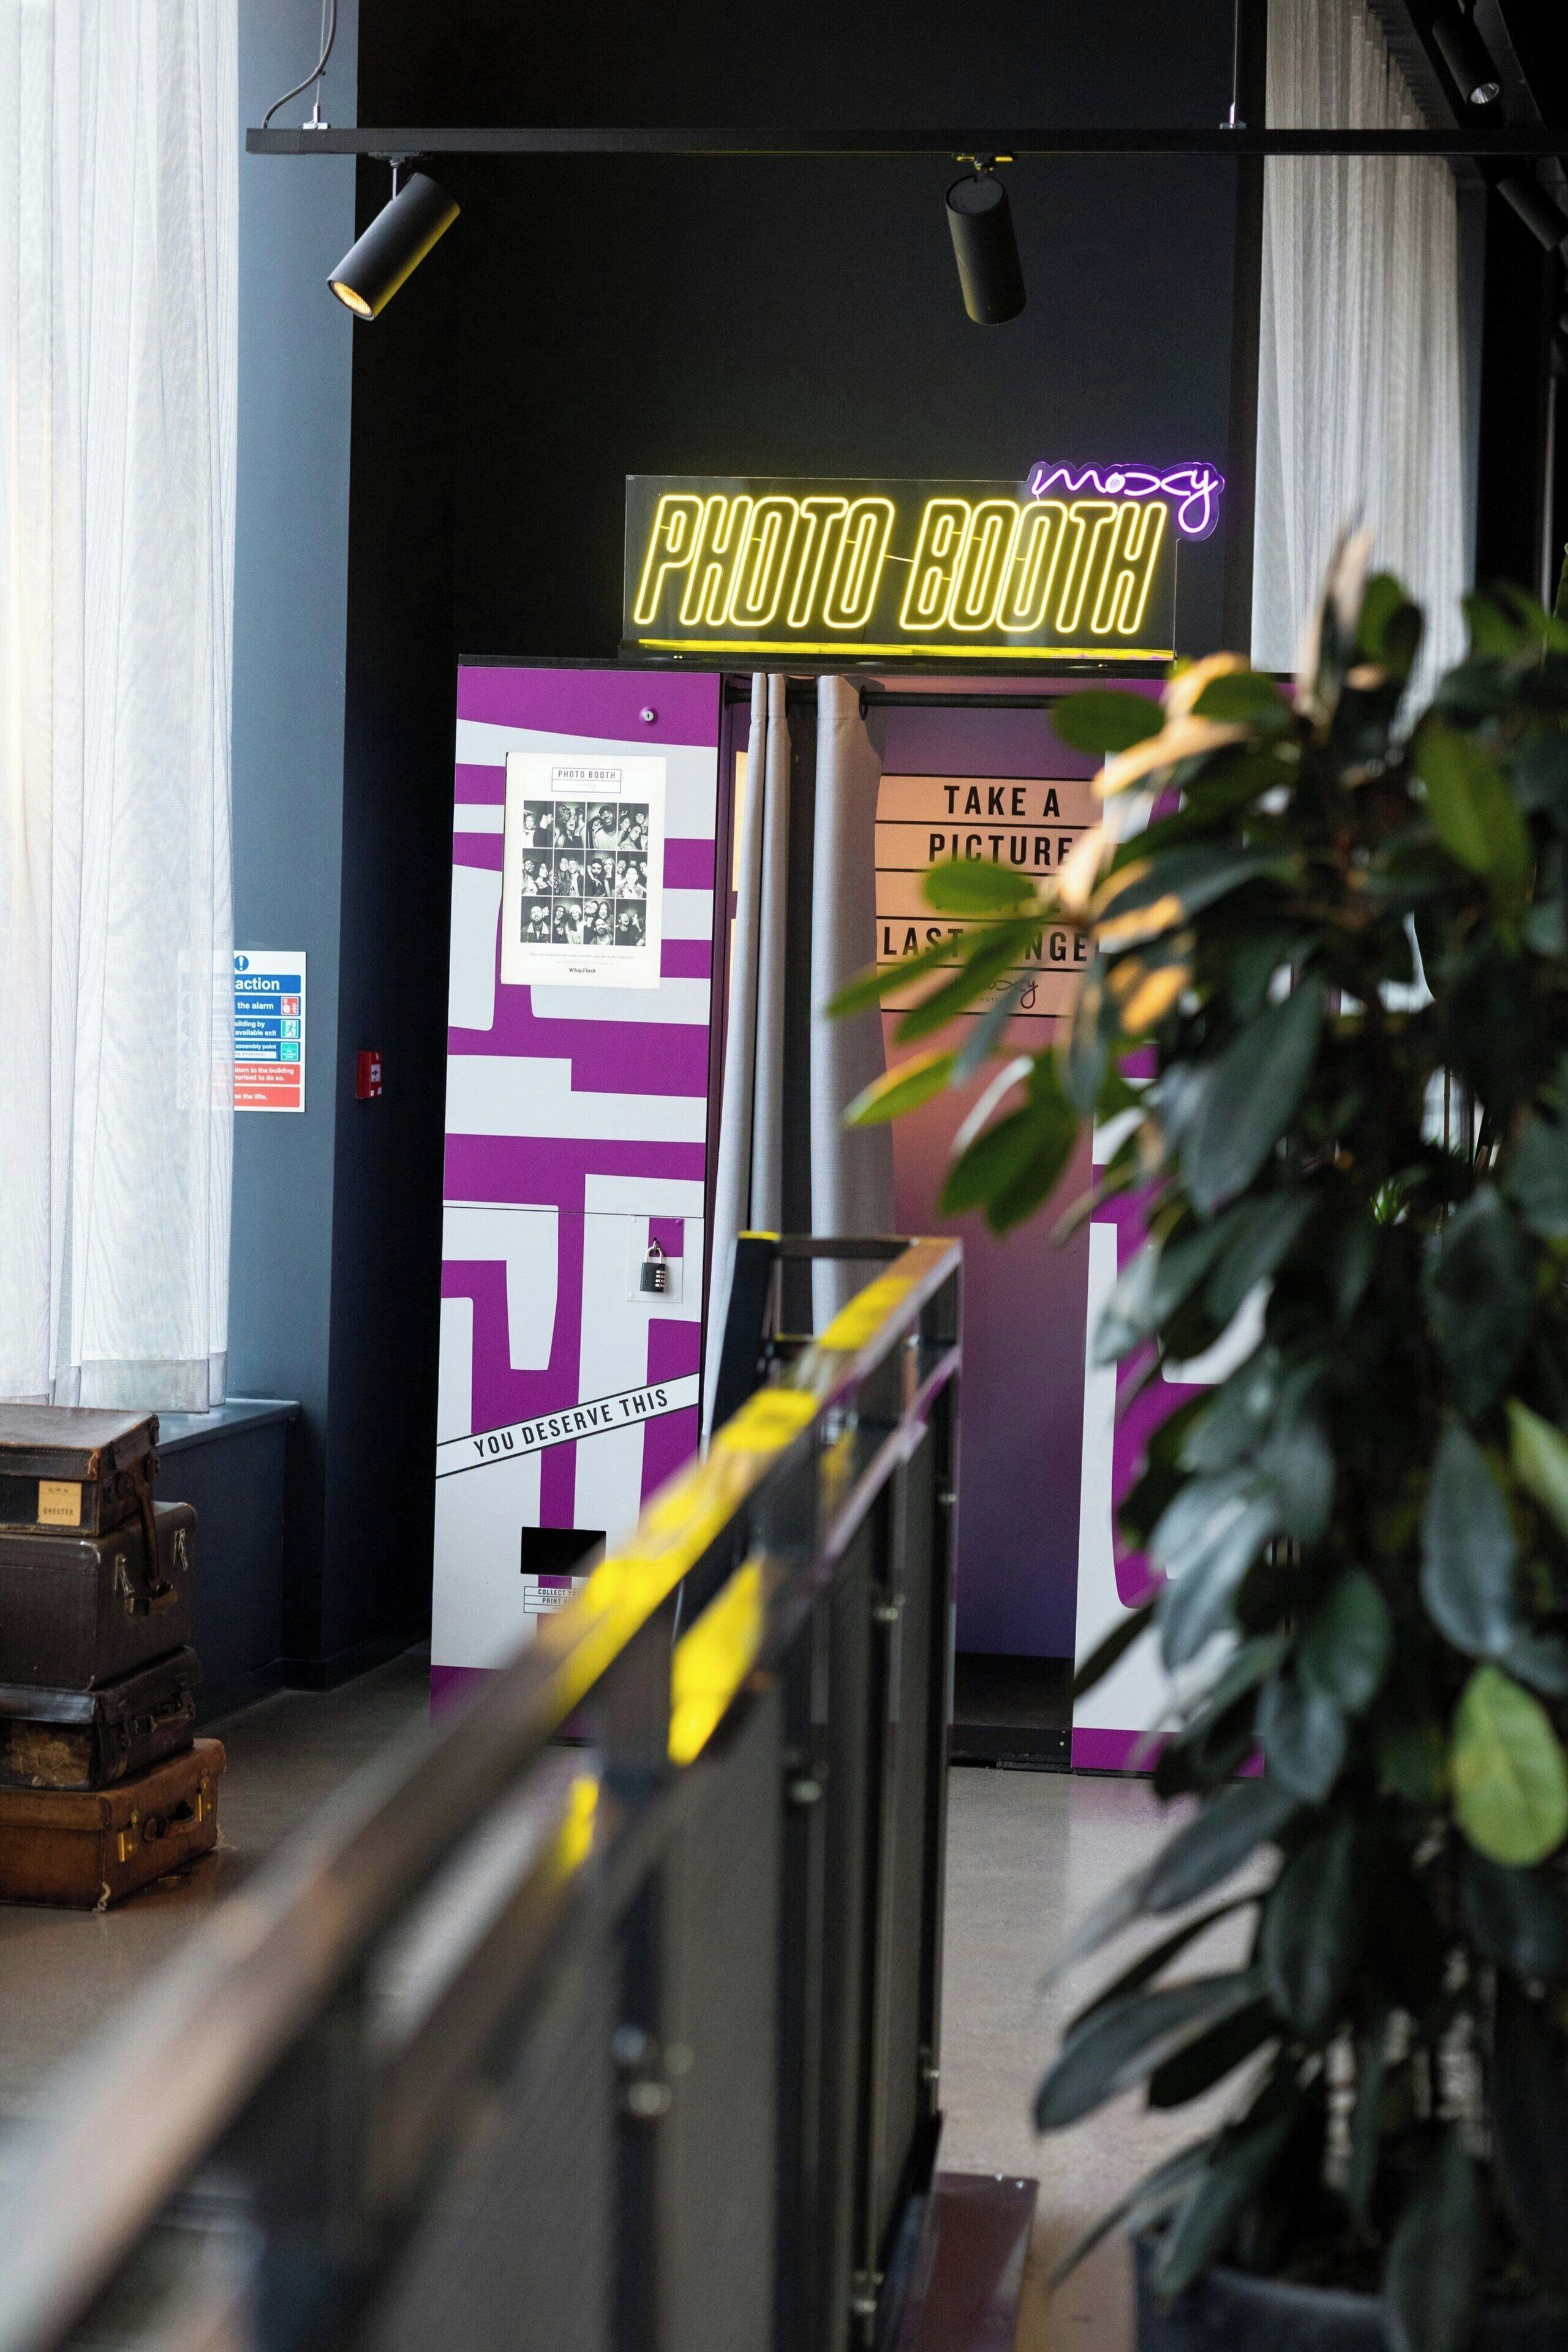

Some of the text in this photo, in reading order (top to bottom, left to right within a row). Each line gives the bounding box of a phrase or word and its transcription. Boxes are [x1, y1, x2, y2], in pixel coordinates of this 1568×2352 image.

[1031, 468, 1218, 534] moxy
[633, 495, 1167, 635] PHOTO BOOTH
[558, 770, 616, 779] PHOTO BOOTH
[944, 785, 1061, 818] TAKE A
[883, 926, 964, 959] LAST
[235, 977, 280, 990] action
[473, 1389, 668, 1458] YOU DESERVE THIS
